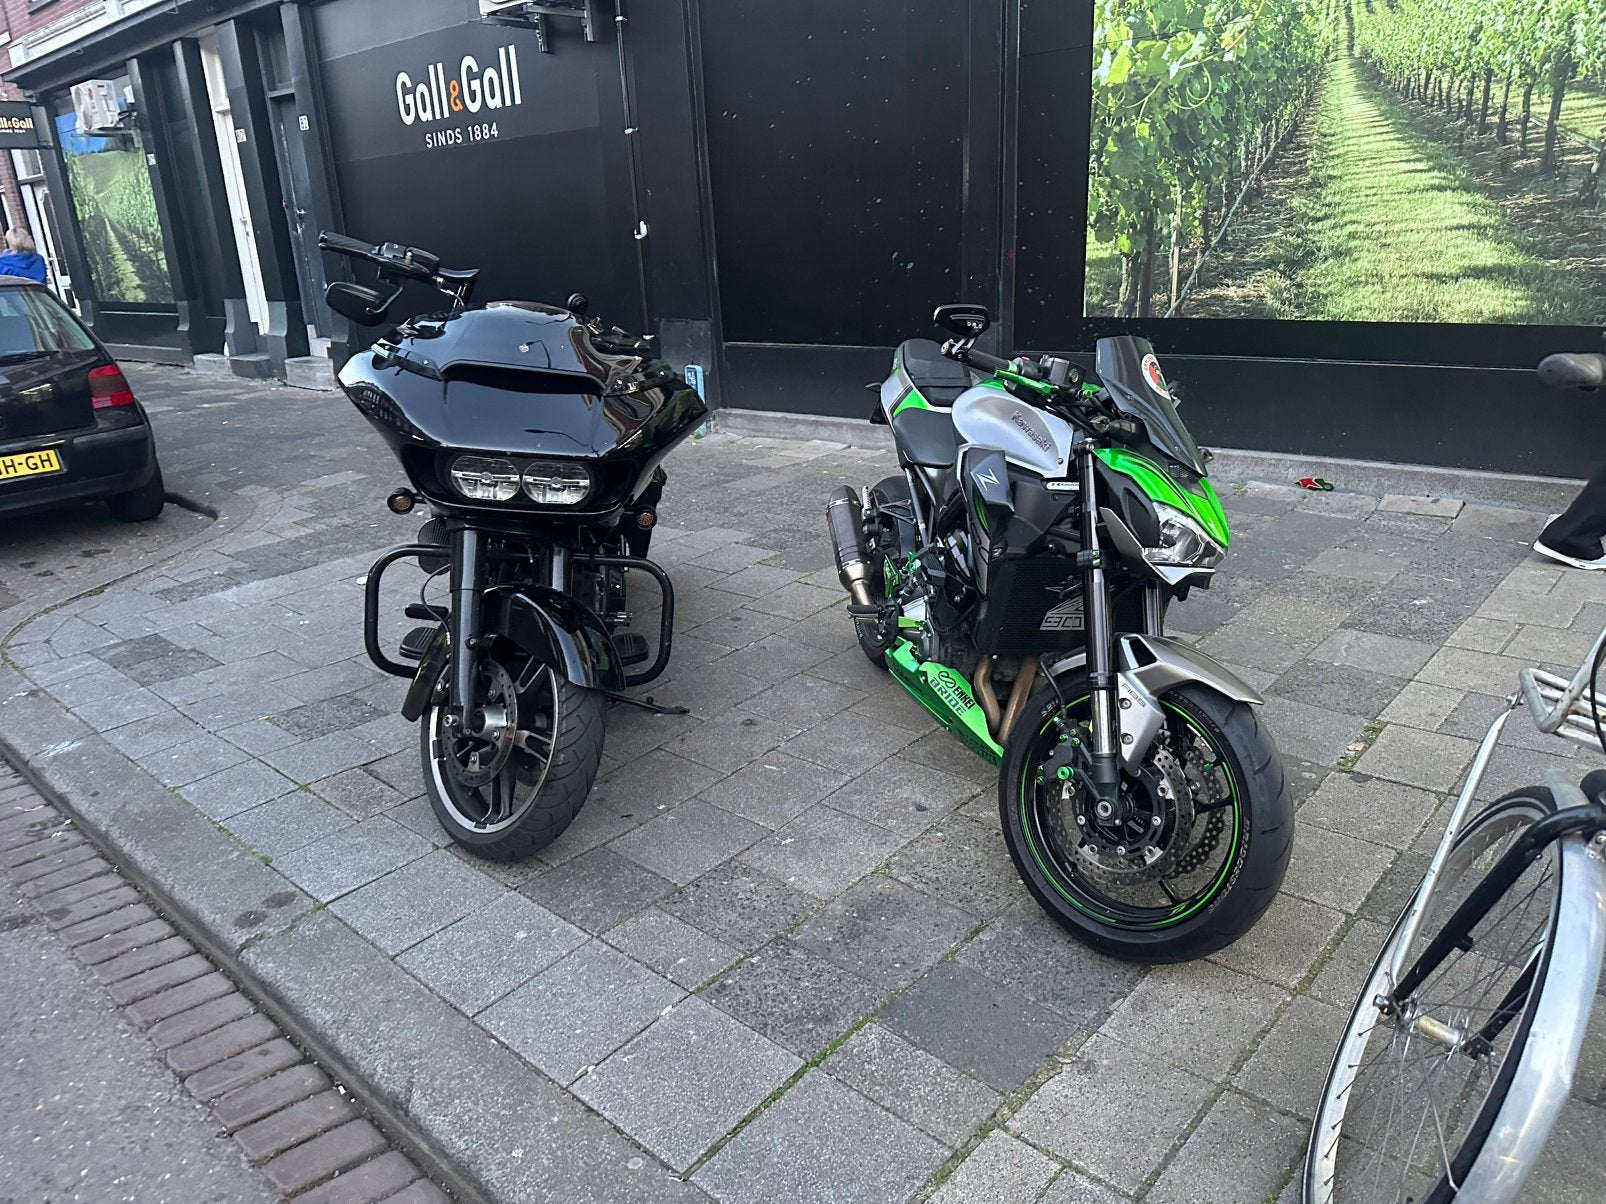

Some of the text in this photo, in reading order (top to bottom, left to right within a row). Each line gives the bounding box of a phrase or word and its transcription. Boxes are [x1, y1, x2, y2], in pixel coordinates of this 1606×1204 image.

[396, 44, 522, 126] Gall&Gall
[0, 117, 34, 129] ll&Gall
[425, 121, 499, 149] SINDS 1884
[1011, 410, 1051, 453] Kawasaki
[0, 453, 53, 475] H-GH
[929, 677, 967, 717] BRIDE
[952, 686, 976, 710] ENKEI
[1121, 682, 1147, 708] ABS
